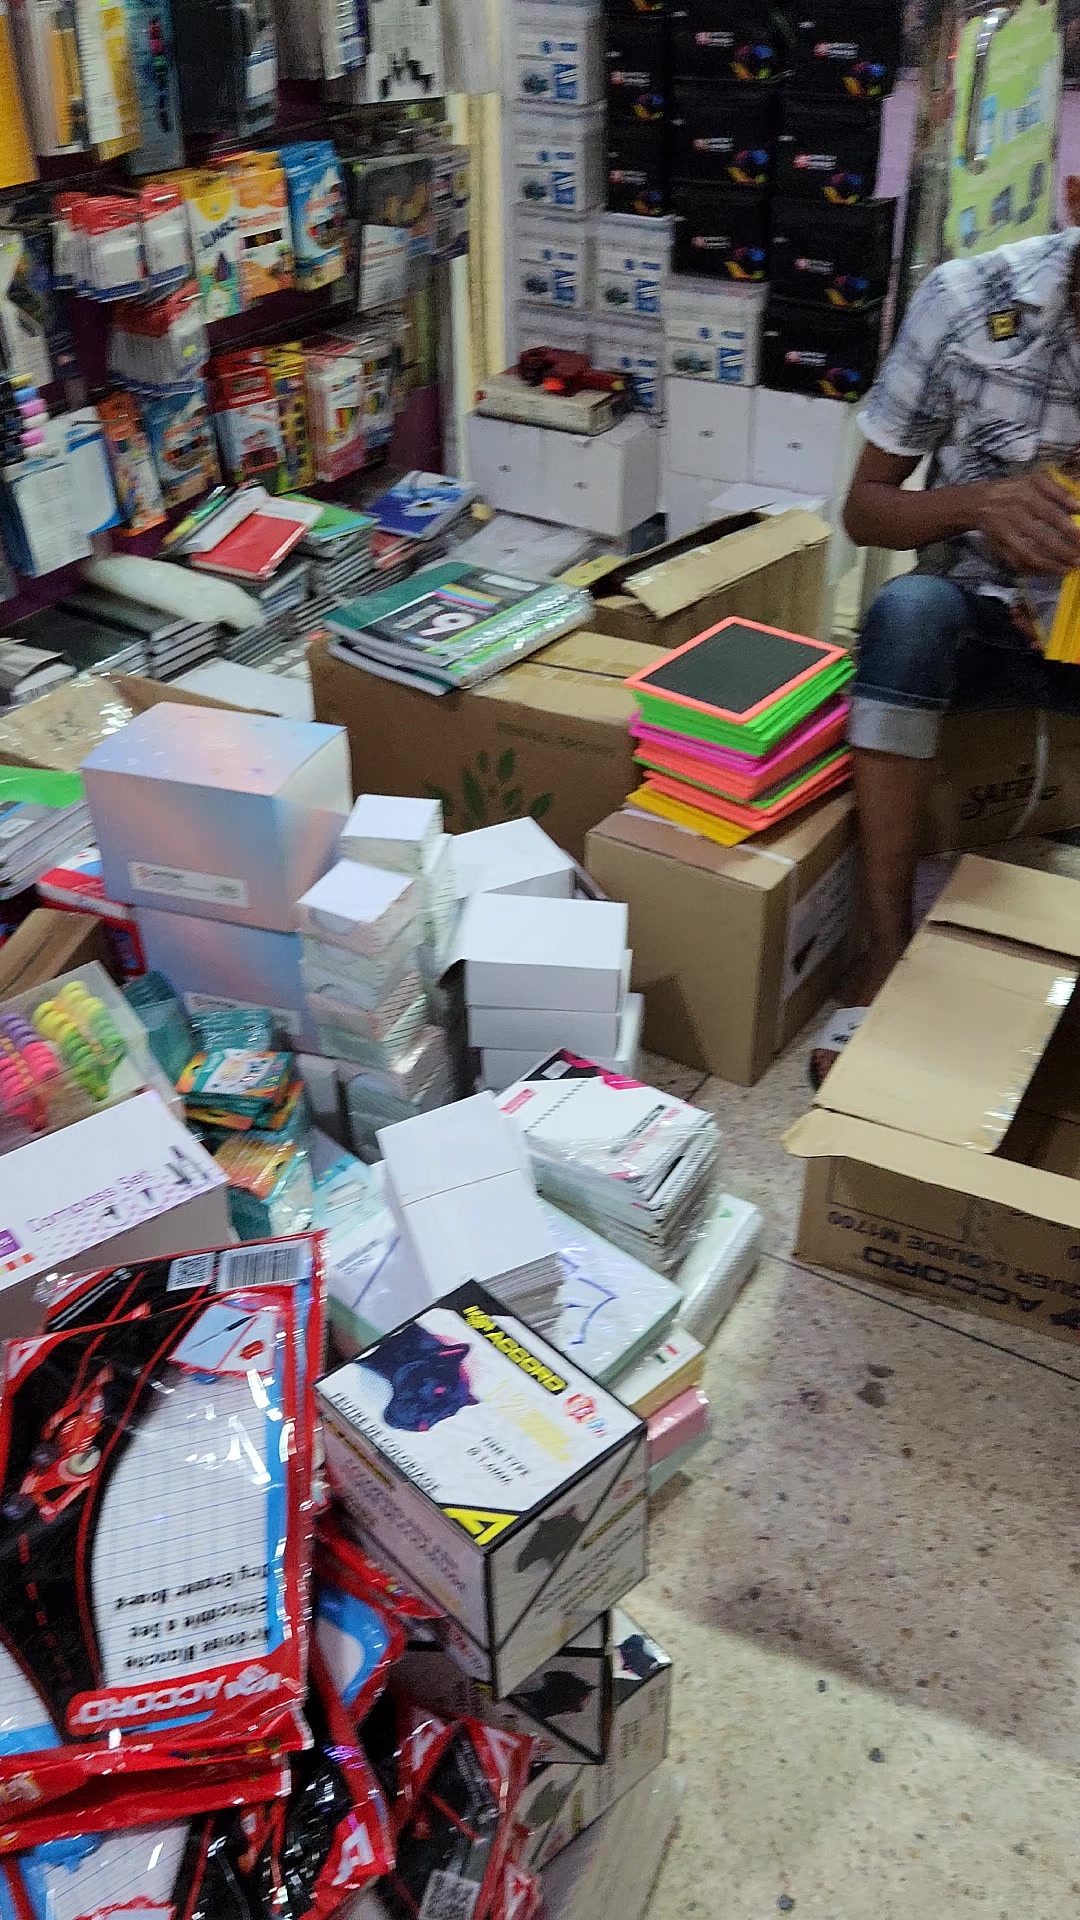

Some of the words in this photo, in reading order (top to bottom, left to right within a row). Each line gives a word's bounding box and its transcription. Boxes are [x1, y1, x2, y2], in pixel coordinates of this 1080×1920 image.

[26, 1185, 116, 1233] Compass
[862, 1247, 1044, 1312] ACCORD
[485, 1330, 568, 1395] ACCORD
[381, 1436, 442, 1494] COLORIAGE
[73, 1675, 225, 1724] ACCORD
